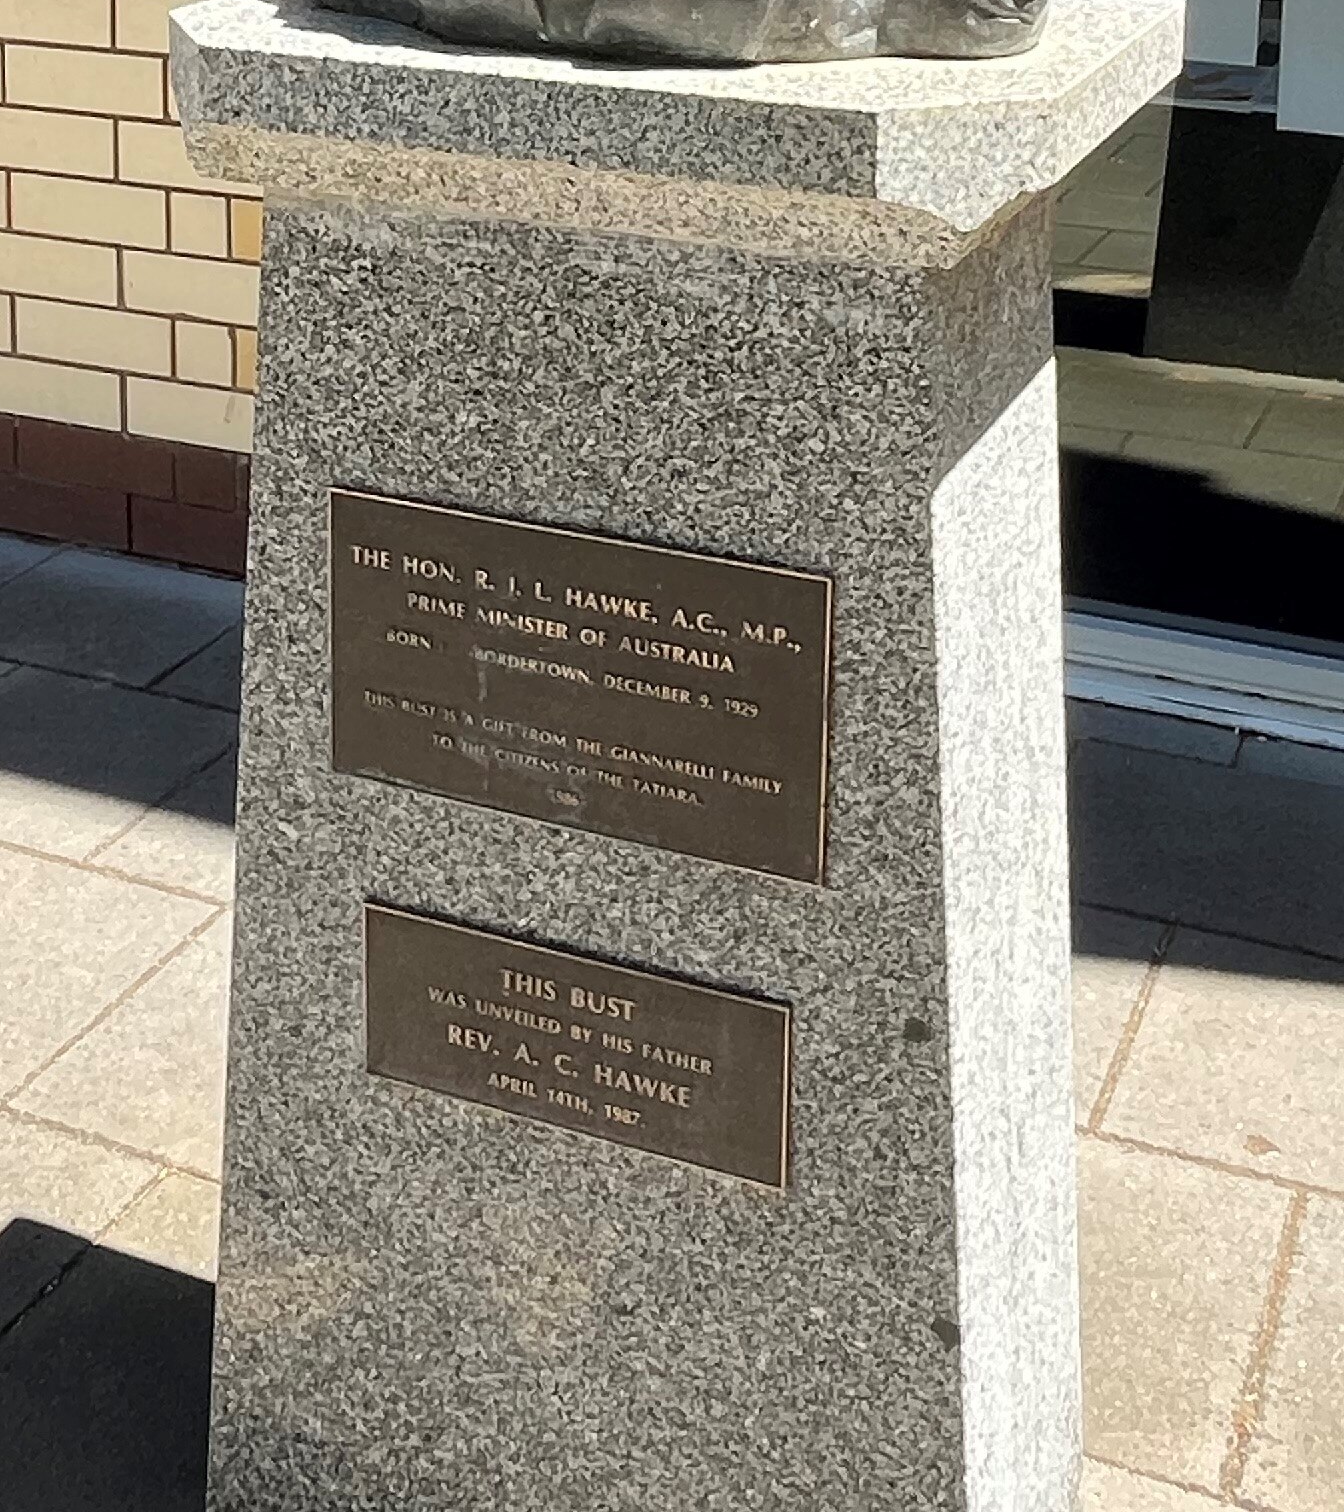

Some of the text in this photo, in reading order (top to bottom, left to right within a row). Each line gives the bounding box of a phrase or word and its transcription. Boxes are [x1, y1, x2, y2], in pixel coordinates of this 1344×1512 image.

[350, 544, 391, 570] THE
[402, 555, 462, 584] HON.
[474, 569, 496, 591] R.
[534, 581, 552, 603] L.
[565, 587, 658, 625] HAWKE,
[671, 608, 728, 638] A.C.,
[741, 621, 802, 655] M.P.,
[407, 592, 736, 674] PRIME MINISTER OF AUSTRALIA
[386, 628, 432, 650] BORN
[604, 674, 692, 705] DECEMBER
[723, 698, 760, 719] 1929
[364, 689, 783, 795] THIS BUST IS A GIFT FROM THE GIANNARELLI FAMILY
[432, 733, 455, 749] TO
[461, 741, 487, 757] THE
[494, 748, 560, 774] CITIZENS
[566, 764, 588, 776] OF
[596, 769, 624, 788] THE
[428, 985, 713, 1076] WAS UNVEILED BY HIS FATHER
[499, 968, 637, 1022] THIS BUST
[447, 1024, 692, 1108] REV. A. C. HAWKE
[486, 1072, 537, 1098] APRIL
